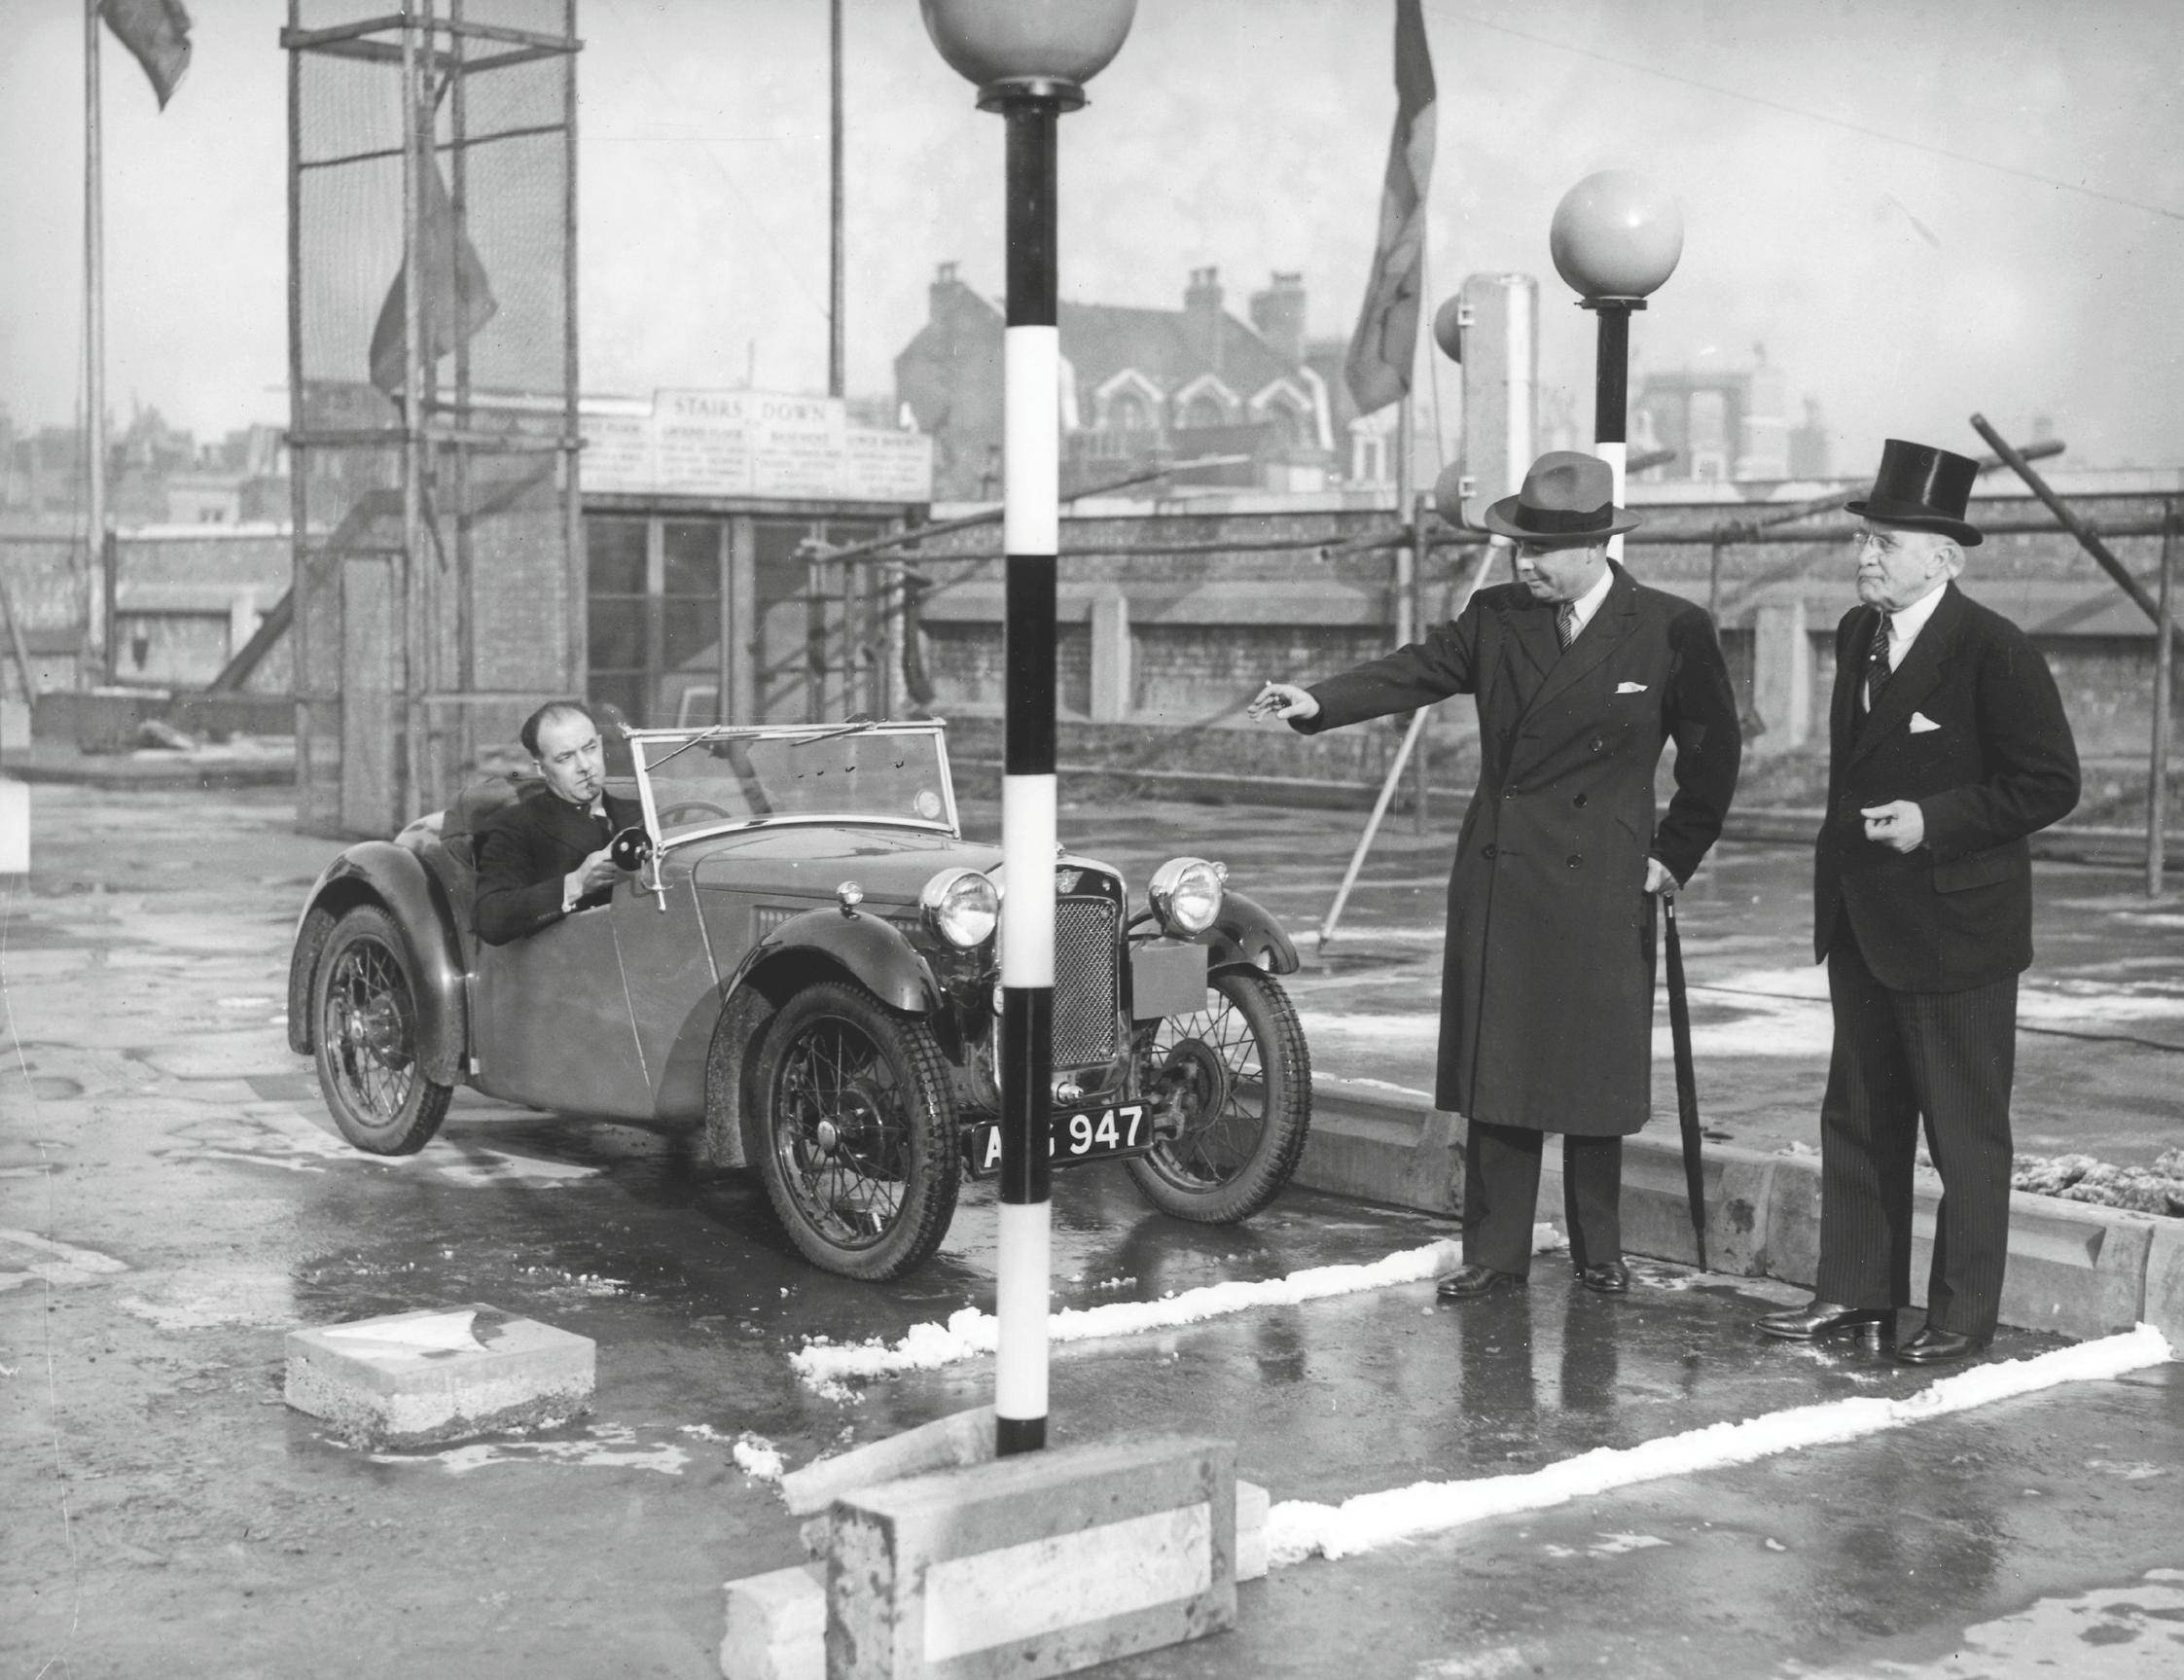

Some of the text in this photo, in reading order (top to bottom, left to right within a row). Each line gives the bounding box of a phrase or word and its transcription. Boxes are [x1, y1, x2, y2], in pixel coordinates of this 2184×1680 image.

[674, 397, 826, 421] STAIRS DOWN
[1069, 1105, 1143, 1155] 947
